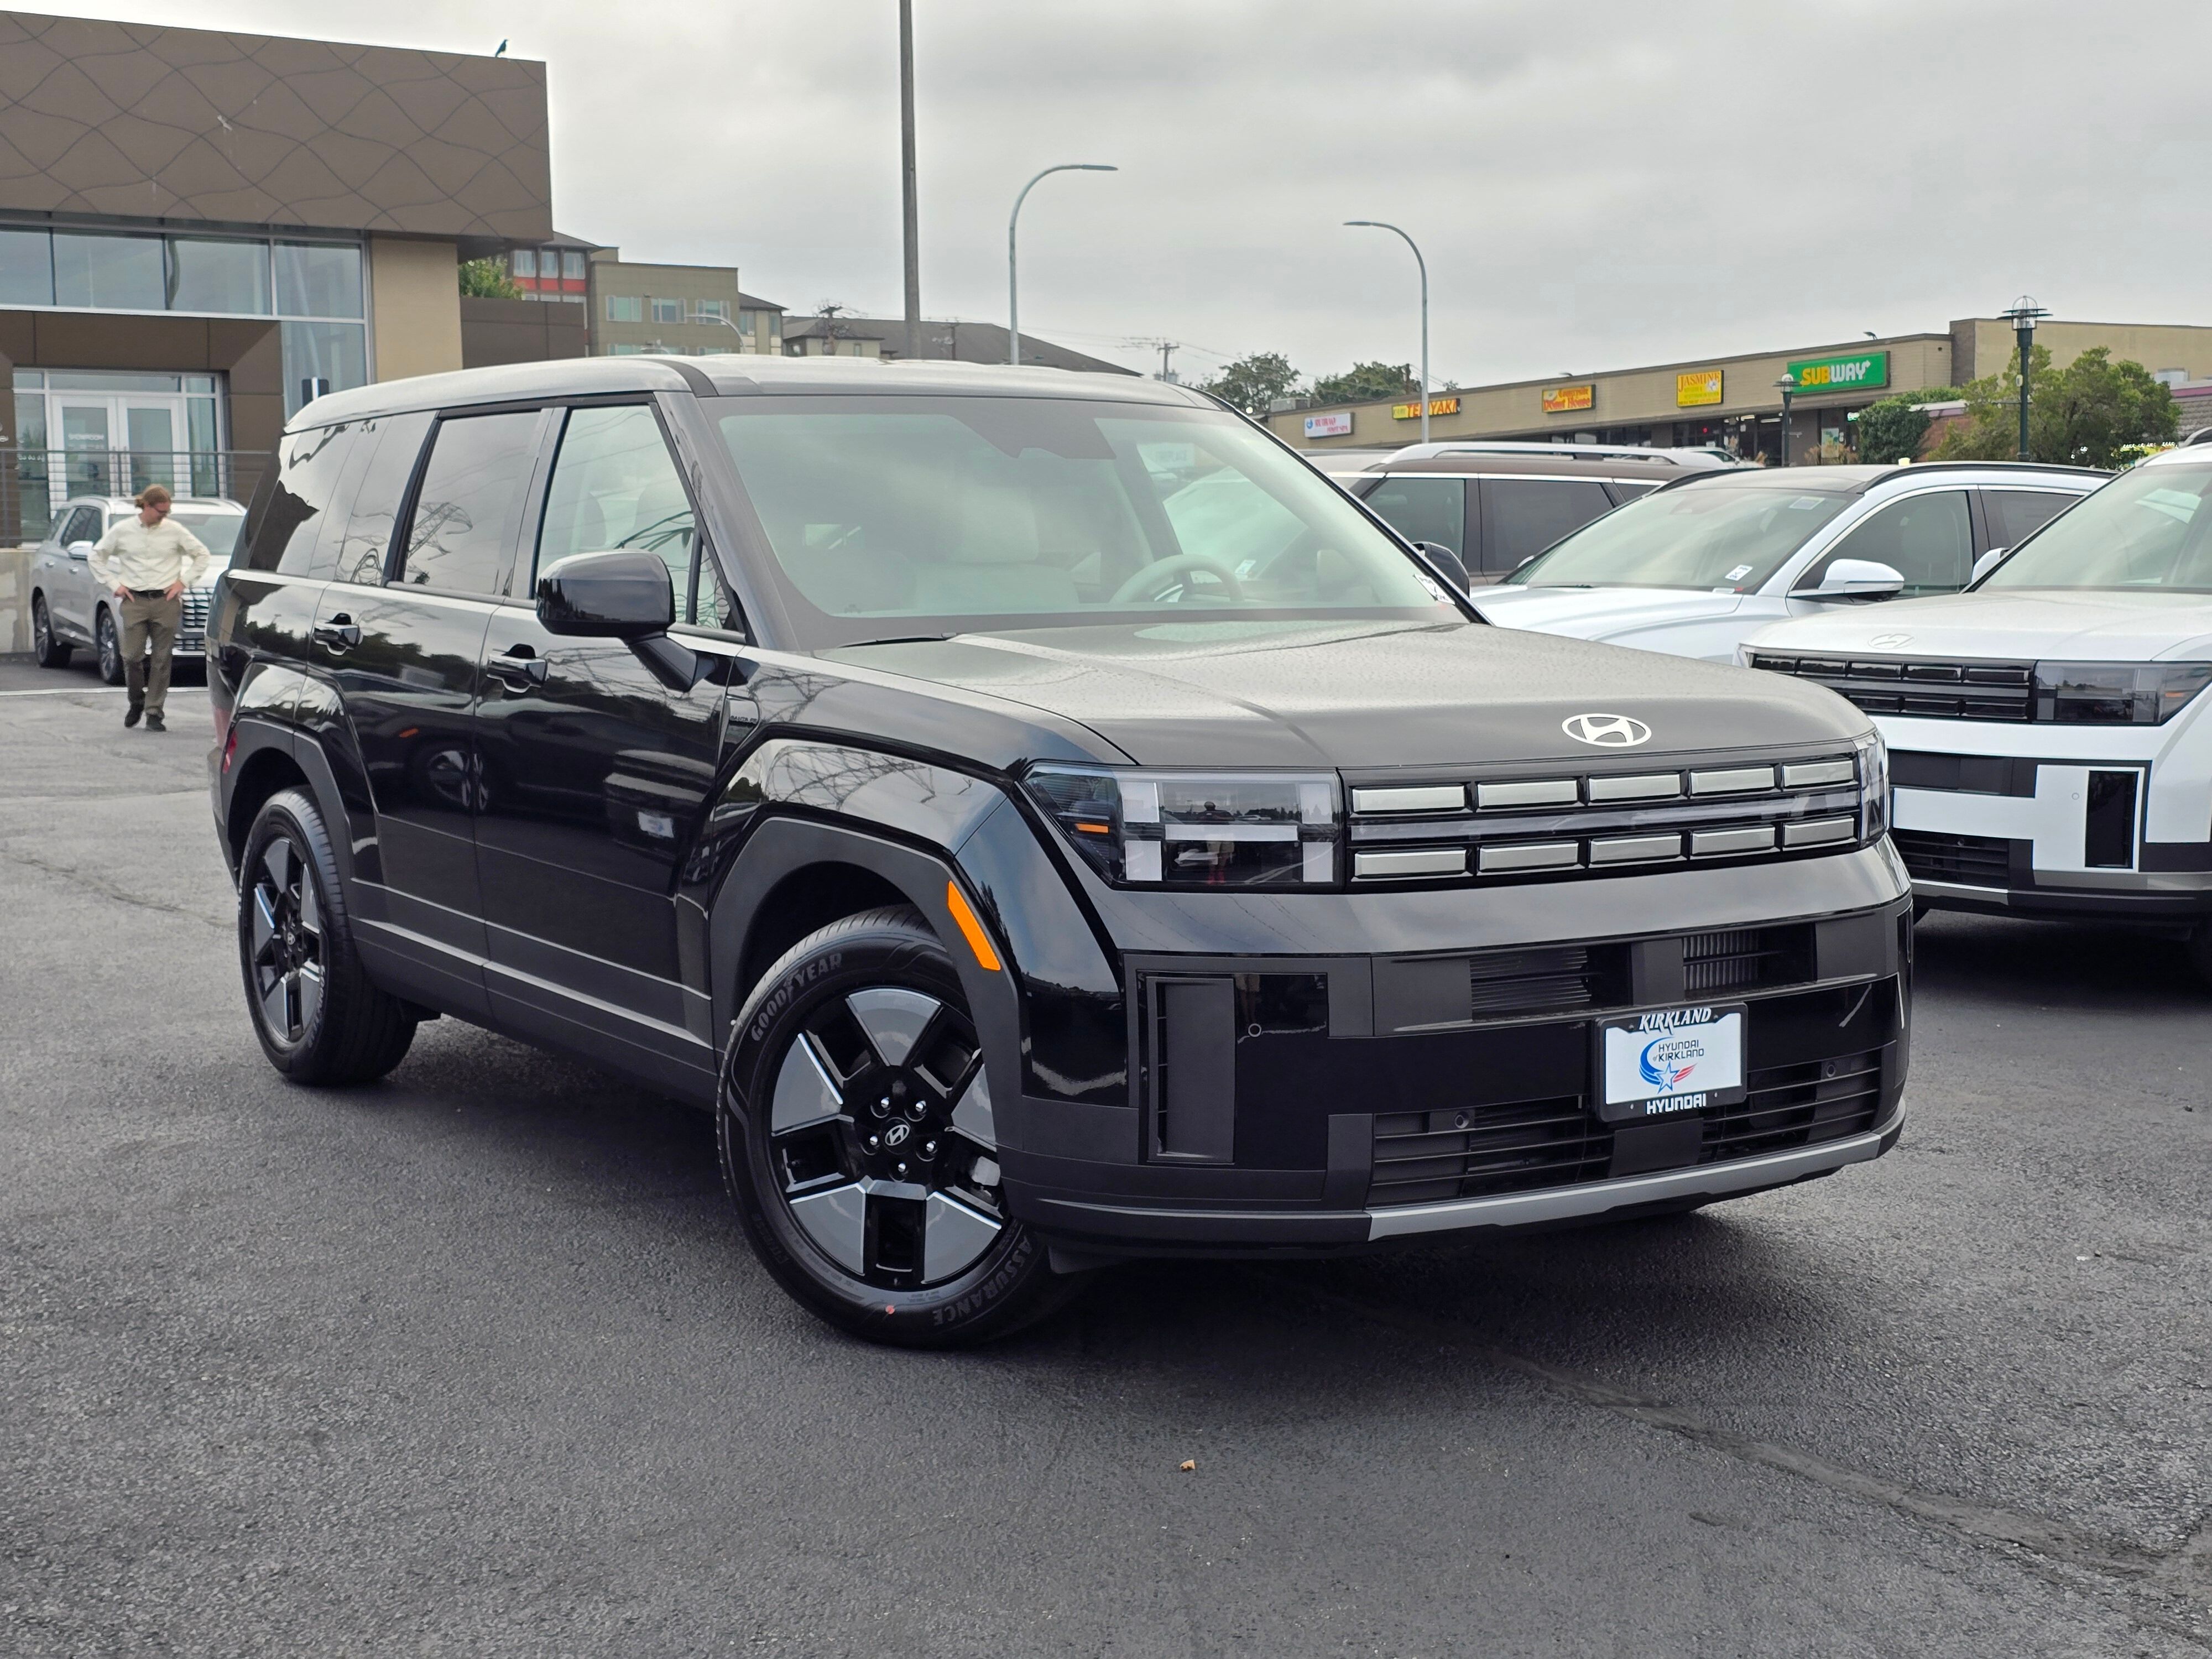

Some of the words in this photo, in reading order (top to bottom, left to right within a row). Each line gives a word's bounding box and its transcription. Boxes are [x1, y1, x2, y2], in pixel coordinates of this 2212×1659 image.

[1678, 372, 1720, 393] JASMINE
[1800, 360, 1871, 385] SUBWAY
[1406, 398, 1457, 418] TEYAKI
[751, 953, 842, 1041] GOODYEAR
[1639, 1008, 1712, 1035] KIRKLAND
[1658, 1040, 1699, 1052] HYUNDAI
[1658, 1048, 1704, 1062] KIRKLAND
[1646, 1093, 1707, 1114] HYUNDAI
[932, 1235, 1032, 1326] ASSURANCE
